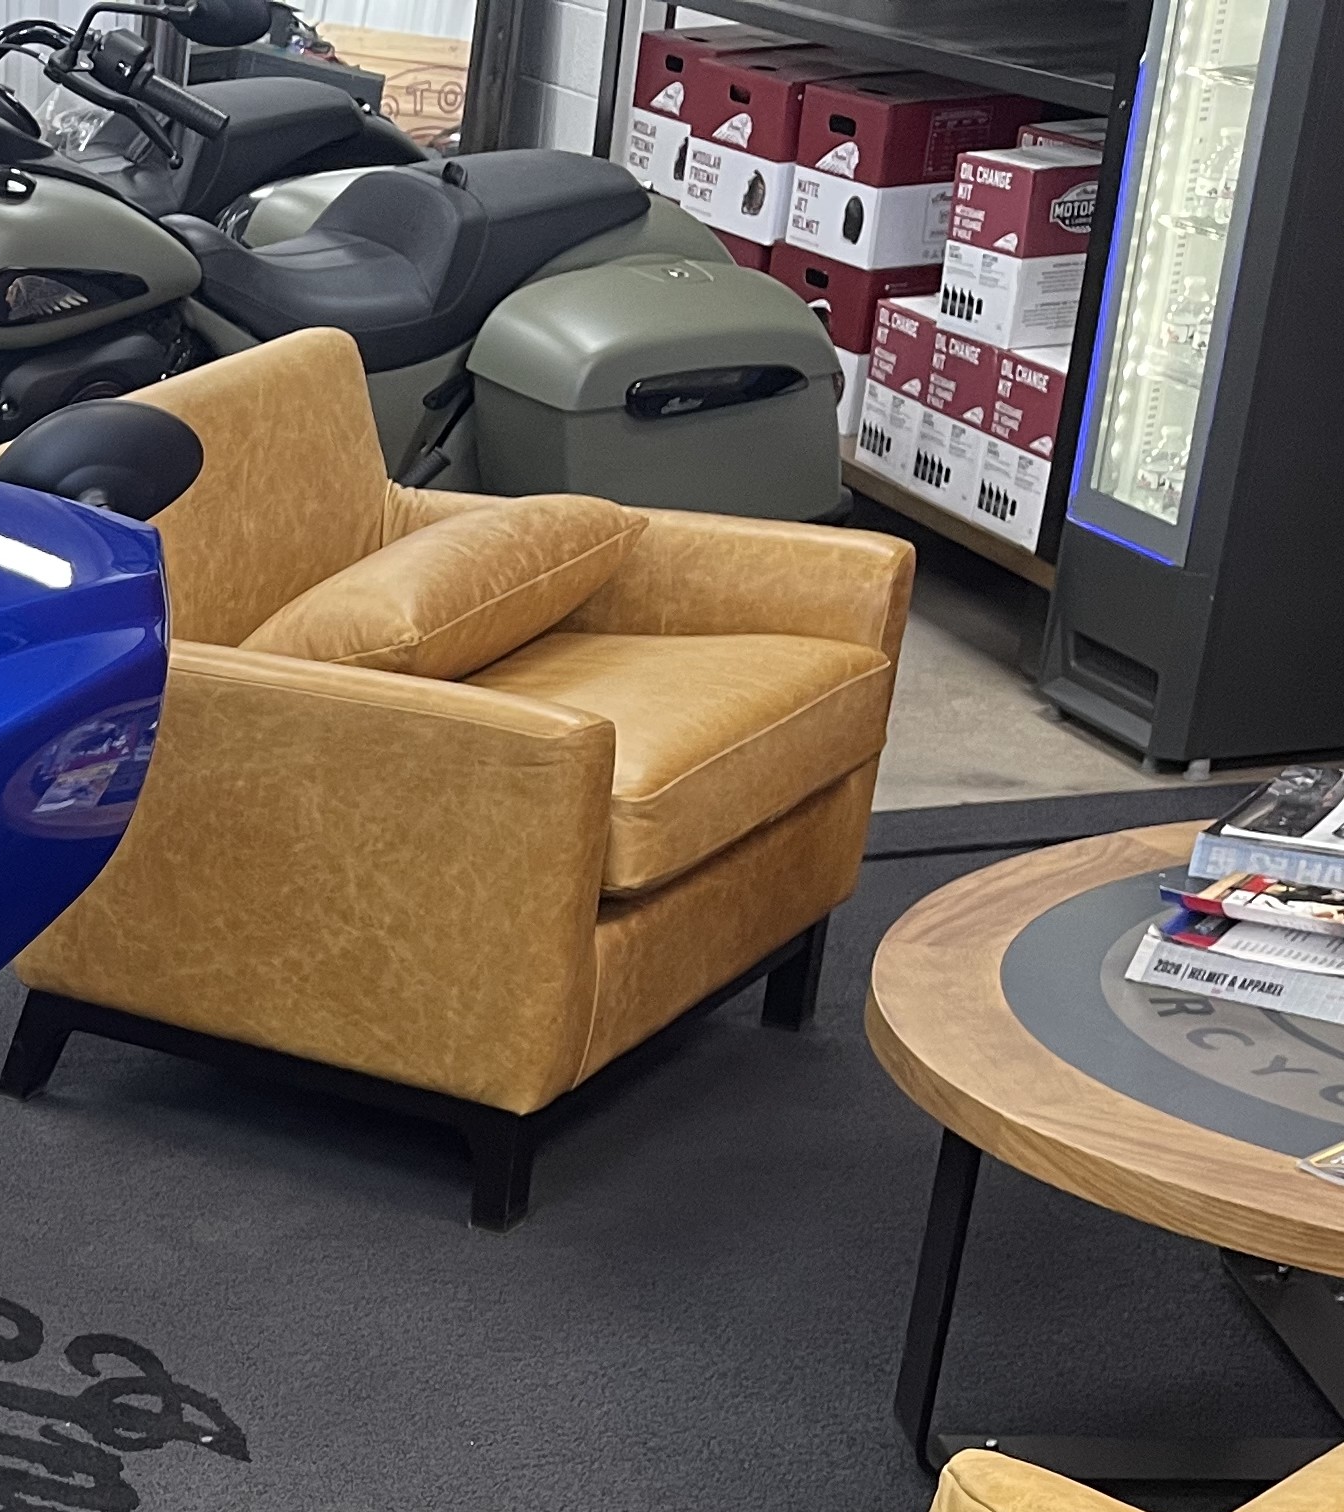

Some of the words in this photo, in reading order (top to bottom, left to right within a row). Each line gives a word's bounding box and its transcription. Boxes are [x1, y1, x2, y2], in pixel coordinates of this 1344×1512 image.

[960, 162, 975, 182] OIL
[976, 166, 1013, 190] CHANGE
[957, 183, 974, 201] KIT
[1001, 358, 1014, 380] OIL
[1015, 363, 1050, 394] CHANGE
[1187, 966, 1230, 986] HELMET
[1238, 977, 1285, 997] APPAREL
